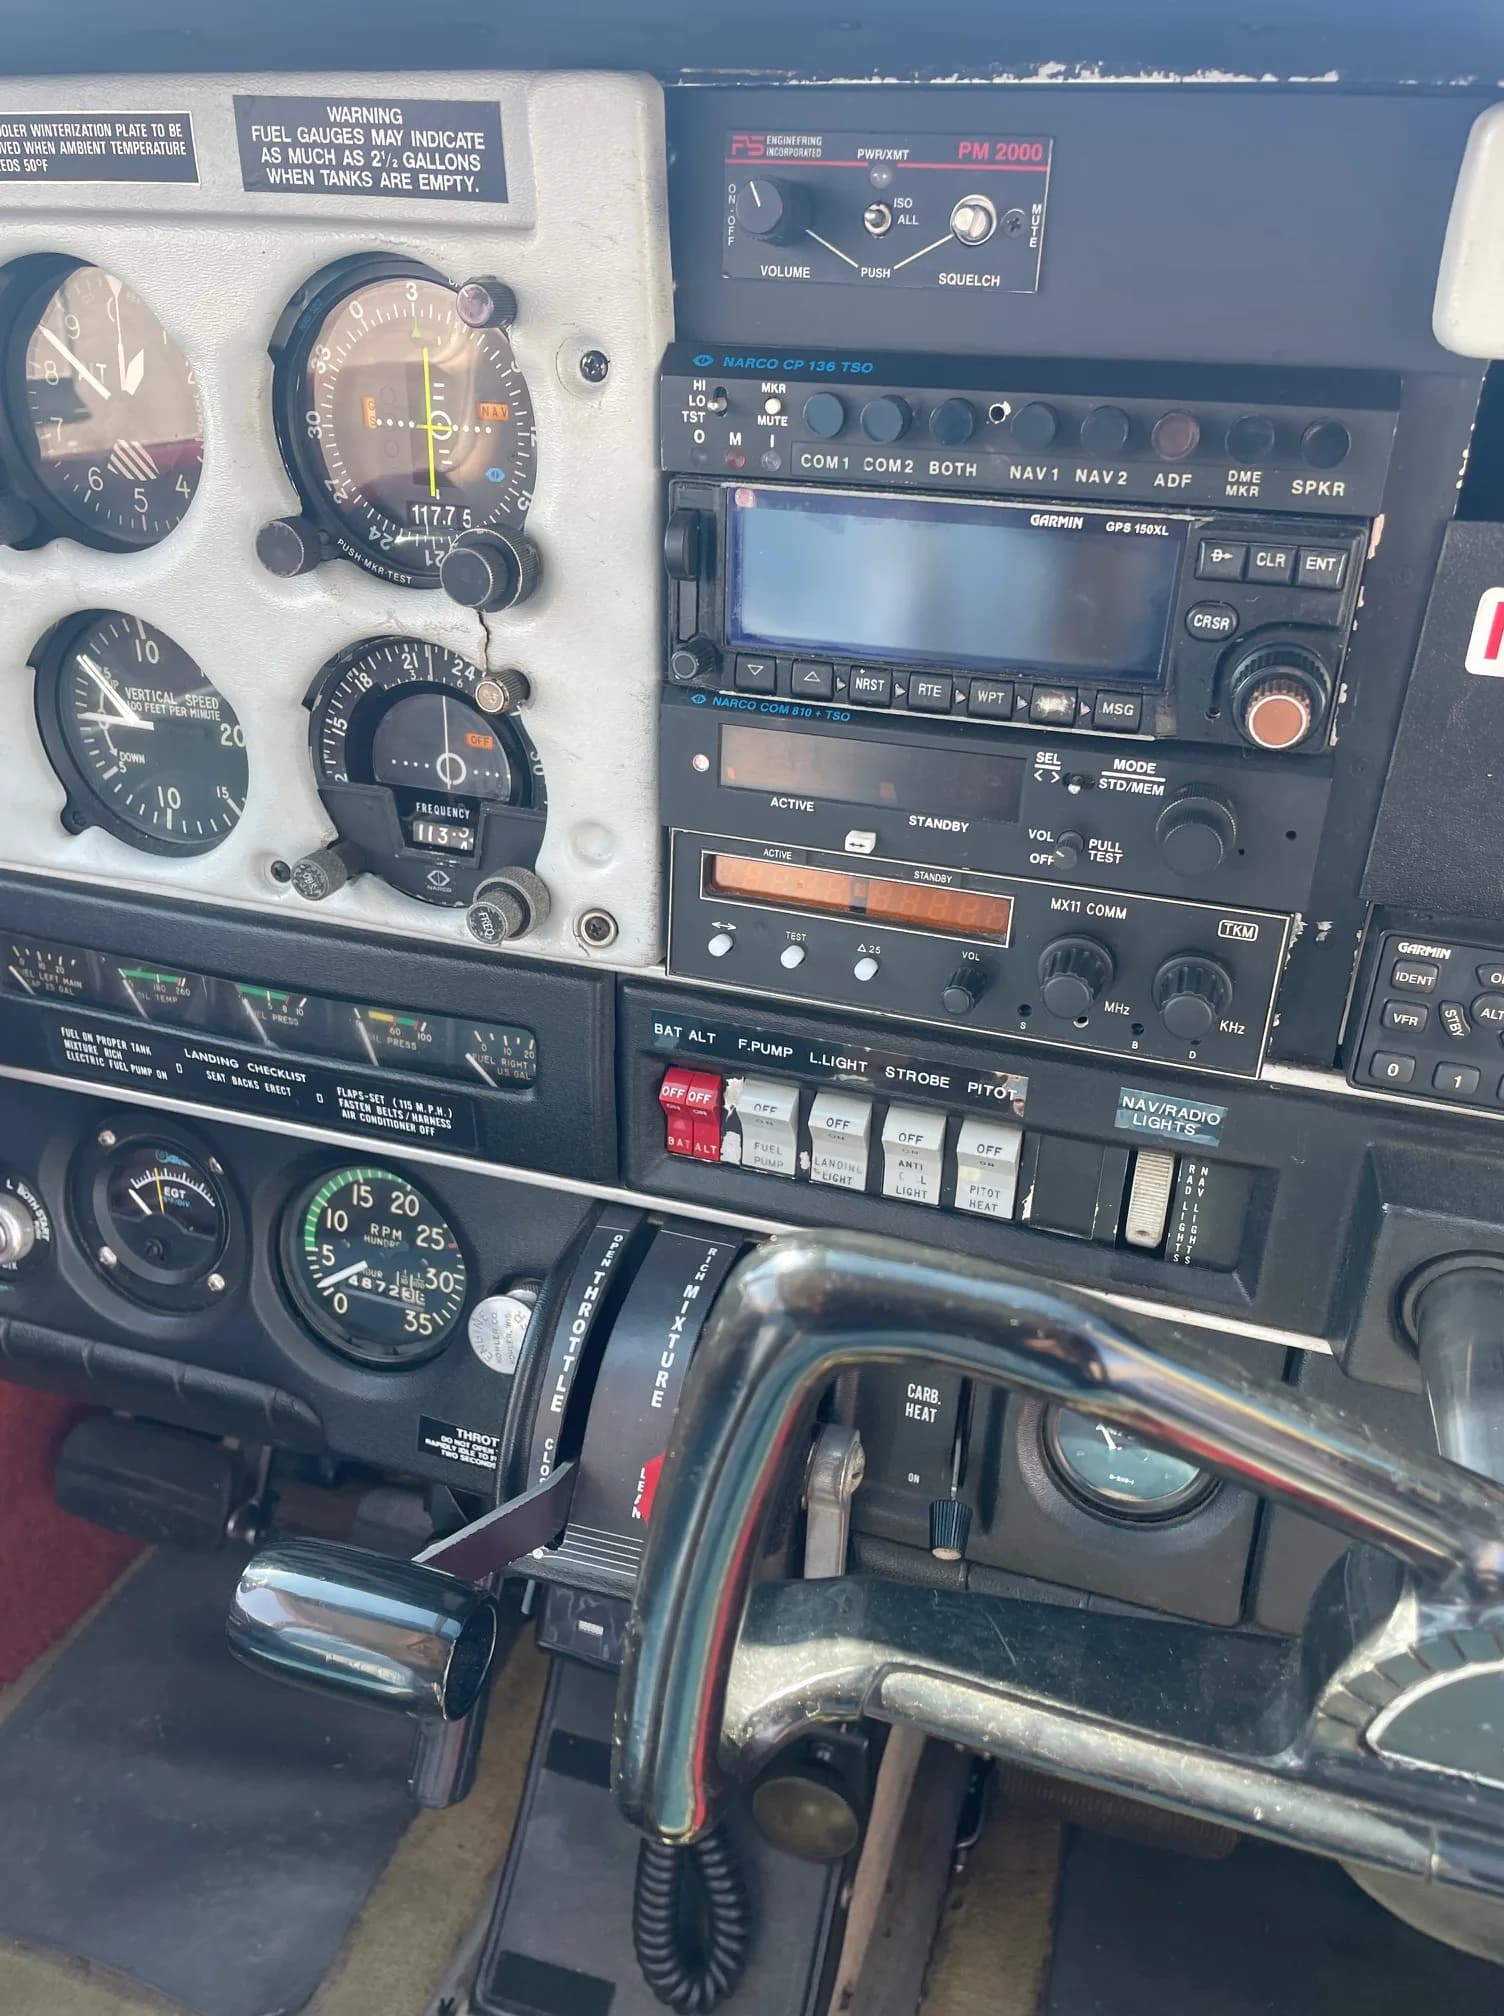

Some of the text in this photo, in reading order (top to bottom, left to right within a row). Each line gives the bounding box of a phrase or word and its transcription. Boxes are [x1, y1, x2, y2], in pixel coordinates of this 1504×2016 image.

[327, 106, 402, 124] WARNING
[0, 124, 182, 137] OLER WINTERIZATION PLATE TO BE
[251, 126, 485, 149] FUEL GAUGES MAY INDICATE
[0, 141, 186, 155] VED WHEN AMBIENT TEMPERATURE
[766, 135, 822, 147] ENGINEERING
[261, 147, 281, 164] AS
[288, 148, 335, 165] MUCH
[342, 150, 365, 166] AS
[403, 152, 480, 172] GALLONS
[766, 147, 822, 158] INCORPORATED
[857, 149, 909, 161] PWR/XMT
[958, 142, 1043, 161] PM 2000
[0, 159, 20, 171] EDS
[266, 167, 479, 193] WHEN TANKS ARE EMPTY.
[893, 198, 913, 209] ISO
[897, 215, 919, 226] ALL
[1029, 203, 1042, 248] MUTE
[760, 264, 1001, 287] VOLUME PUSH SQUELCH
[722, 356, 874, 374] NARCO CP 136 TSO
[693, 380, 706, 391] HI
[761, 382, 786, 394] MKR
[689, 395, 706, 407] LO
[681, 411, 706, 423] TST
[757, 415, 788, 427] MUTE
[929, 461, 978, 478] BOTH
[1227, 470, 1262, 484] DME
[1153, 473, 1192, 489] ADF
[1291, 480, 1346, 497] SPKR
[1225, 485, 1260, 498] MKR
[133, 488, 149, 512] 5
[1030, 514, 1169, 536] GARMIN GPS 150XL
[1256, 553, 1285, 568] CLR
[1305, 556, 1336, 572] ENT
[1193, 614, 1230, 632] CRSR
[855, 677, 885, 693] NRST
[918, 682, 942, 698] RTE
[125, 687, 219, 710] VERTICAL SPEED
[977, 690, 1005, 706] WPT
[145, 702, 221, 721] FEET PER MINUTE
[712, 696, 851, 722] NARCO COM 810 TSO
[1102, 702, 1135, 717] MSG
[120, 751, 146, 764] DOWN
[1036, 751, 1061, 765] SEL
[1113, 758, 1157, 775] MODE
[1098, 778, 1164, 796] STD/MEM
[416, 802, 470, 819] FREQUENCY
[770, 797, 815, 812] ACTIVE
[908, 815, 970, 833] STANDBY
[1028, 828, 1055, 842] VOL
[763, 848, 792, 860] ACTIVE
[1088, 839, 1123, 854] PULL
[1029, 852, 1055, 866] OFF
[1088, 850, 1124, 864] TEST
[913, 870, 953, 884] STANDBY
[1050, 898, 1128, 920] MX11 COMM
[785, 931, 807, 942] TEST
[1223, 923, 1255, 939] TKM
[961, 950, 981, 962] VOL
[1397, 942, 1452, 959] GARMIN
[1395, 970, 1436, 986] IDENT
[1104, 1001, 1131, 1015] MHz
[1219, 1020, 1246, 1035] KHz
[1393, 1013, 1419, 1027] VFR
[1444, 1009, 1465, 1037] STBY
[61, 1027, 152, 1056] FUEL ON PROPER TANK
[63, 1039, 122, 1060] MIXTURE RICH
[66, 1050, 168, 1081] ELECTRIC FUEL PUMP ON
[184, 1048, 307, 1083] LANDING CHECKLIST
[654, 1023, 1017, 1102] BAT ALT F.PUMP L.LIGHT STROBE PITOT
[206, 1070, 293, 1097] SEAT BACKS ERECT
[337, 1086, 385, 1105] FLAPS-SET
[661, 1086, 685, 1100] OFF
[688, 1090, 712, 1104] OFF
[339, 1098, 371, 1115] FASTEN
[754, 1103, 777, 1114] OFF
[1122, 1096, 1221, 1126] NAV/RADIO
[341, 1108, 435, 1137] AIR CONDITIONER OFF
[826, 1117, 850, 1130] OFF
[1132, 1113, 1196, 1136] LIGHTS
[667, 1136, 690, 1151] BAT
[898, 1131, 924, 1145] OFF
[694, 1141, 717, 1155] ALT
[976, 1143, 1003, 1156] OFF
[898, 1158, 924, 1172] ANTI
[822, 1171, 854, 1186] LIGHT
[164, 1186, 186, 1199] EGT
[352, 1183, 373, 1208] 15
[895, 1185, 928, 1200] LIGHT
[969, 1184, 1001, 1199] PITOT
[390, 1191, 420, 1217] 20
[969, 1198, 998, 1213] HEAT
[326, 1209, 348, 1232] 10
[416, 1224, 445, 1250] 25
[601, 1235, 623, 1267] OPEN
[696, 1248, 718, 1280] RICH
[425, 1267, 454, 1293] 30
[404, 1310, 433, 1335] 35
[551, 1271, 605, 1413] THROTTLE
[651, 1285, 701, 1408] MIXTURE
[907, 1383, 941, 1405] CARB.
[905, 1403, 937, 1423] HEAT
[908, 1473, 919, 1484] ON
